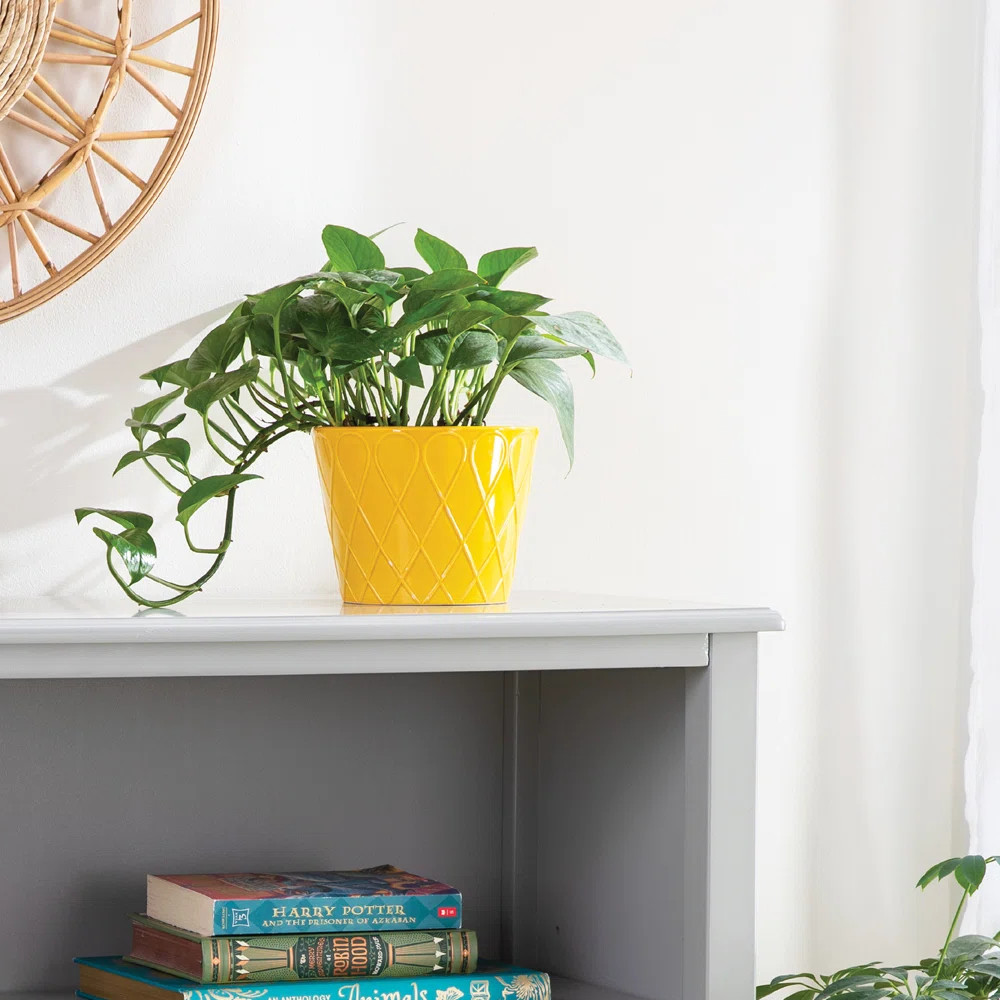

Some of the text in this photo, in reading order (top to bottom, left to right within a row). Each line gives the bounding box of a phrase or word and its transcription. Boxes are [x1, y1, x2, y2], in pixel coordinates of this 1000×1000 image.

[272, 904, 406, 918] HARRY POTTER
[262, 919, 284, 927] AND
[286, 919, 306, 927] THE
[308, 917, 354, 926] PRISONER
[372, 916, 416, 925] AZKABAN
[308, 946, 316, 970] MERRY
[351, 936, 368, 975] HOOD
